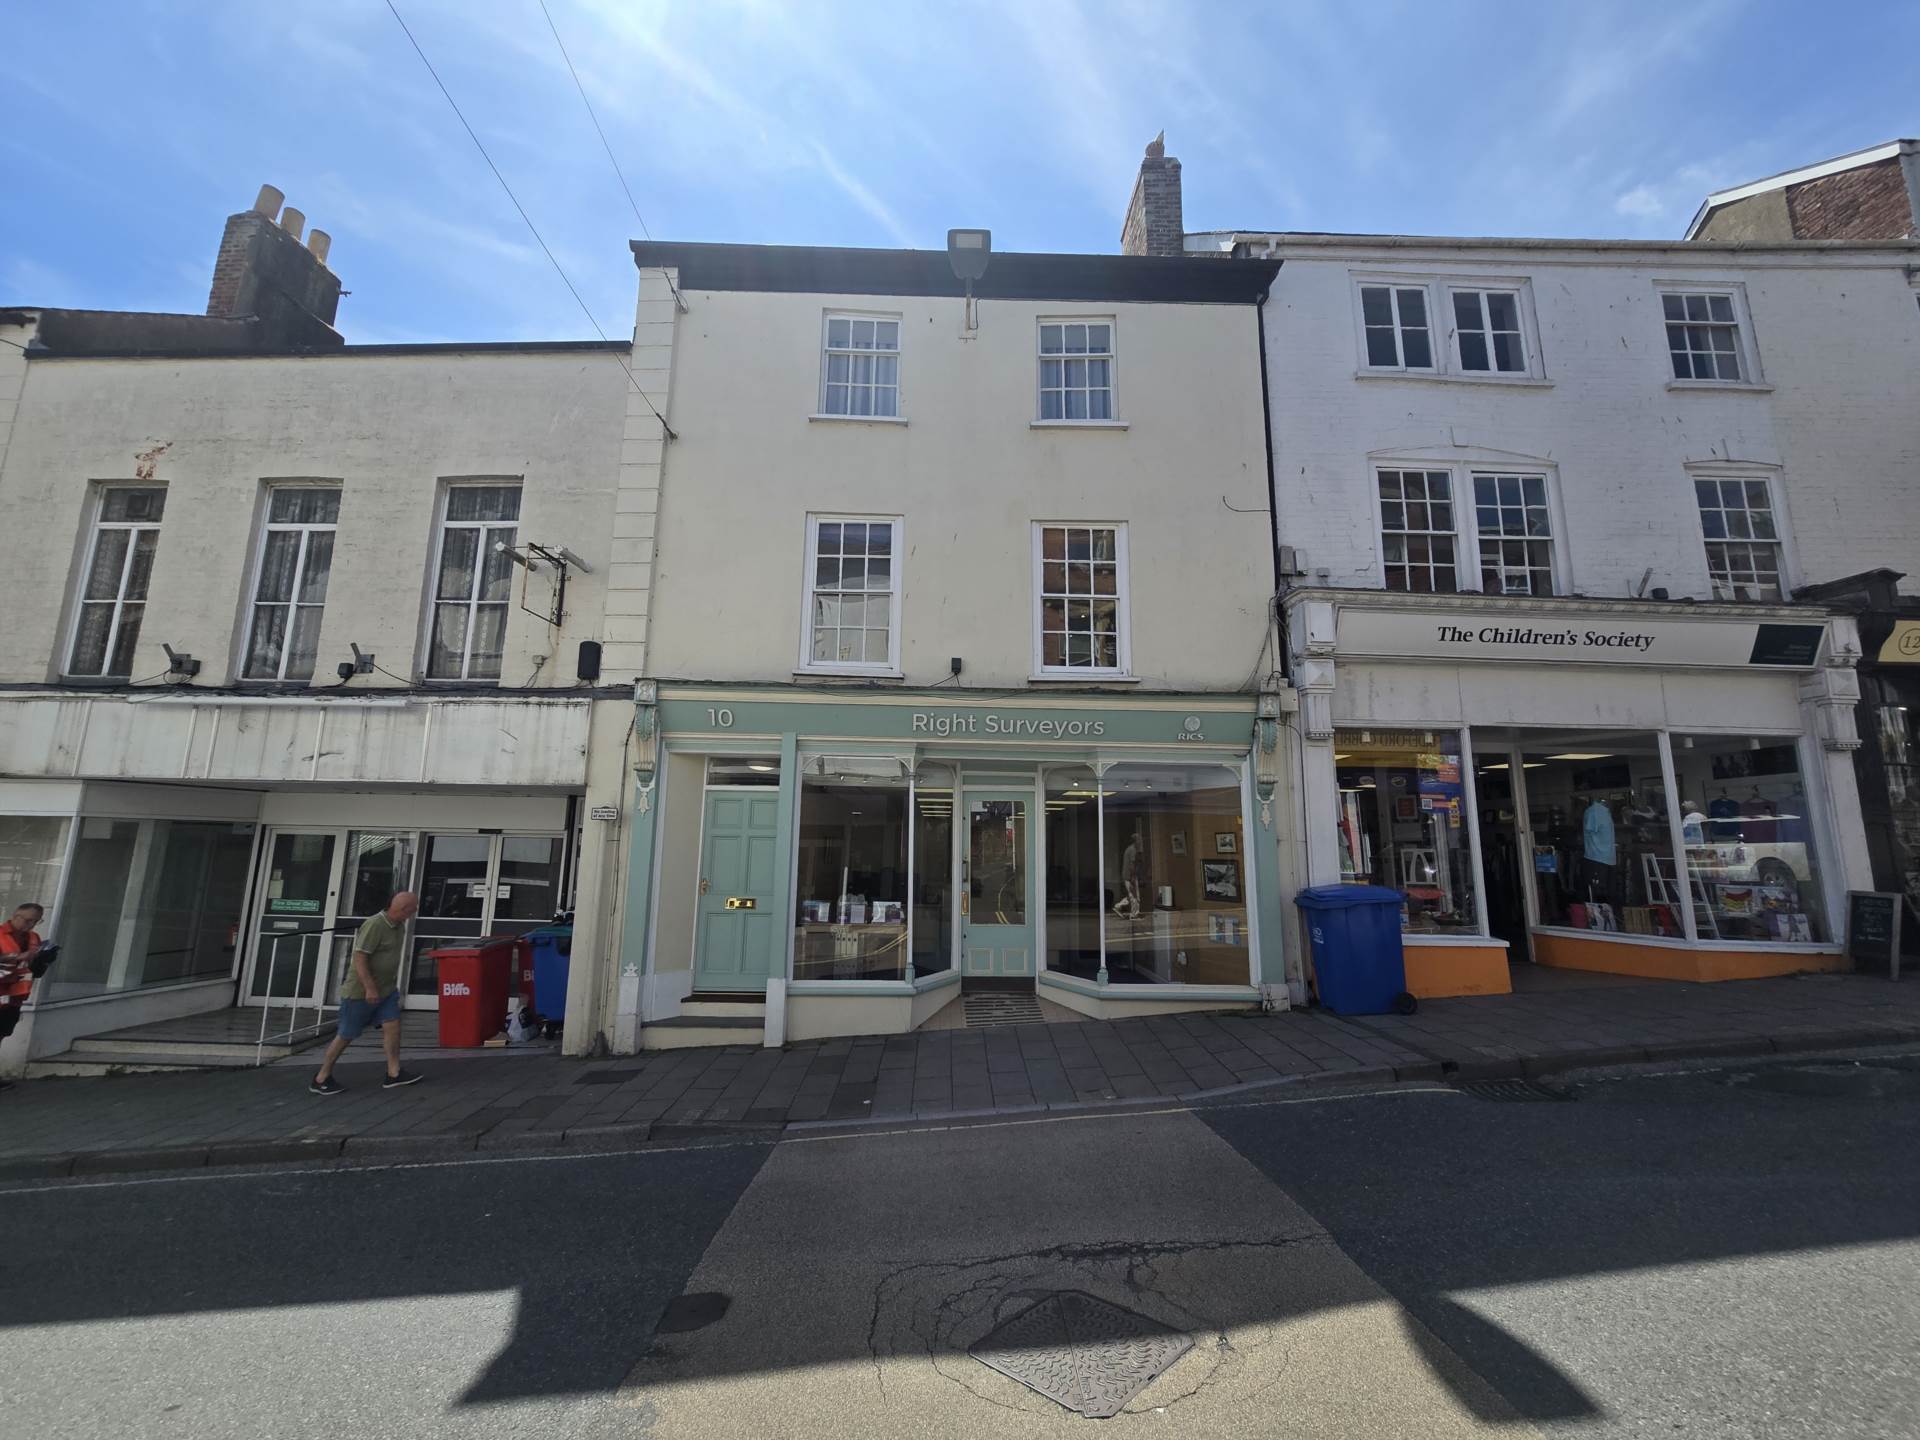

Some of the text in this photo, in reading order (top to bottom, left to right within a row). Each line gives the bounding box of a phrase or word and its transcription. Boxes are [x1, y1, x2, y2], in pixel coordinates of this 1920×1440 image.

[1437, 626, 1656, 652] The Children's Society
[1904, 635, 1920, 649] 12
[707, 708, 734, 728] 10
[911, 713, 1105, 739] Right Surveyors
[1177, 733, 1204, 741] RICS
[443, 983, 470, 996] Biffa
